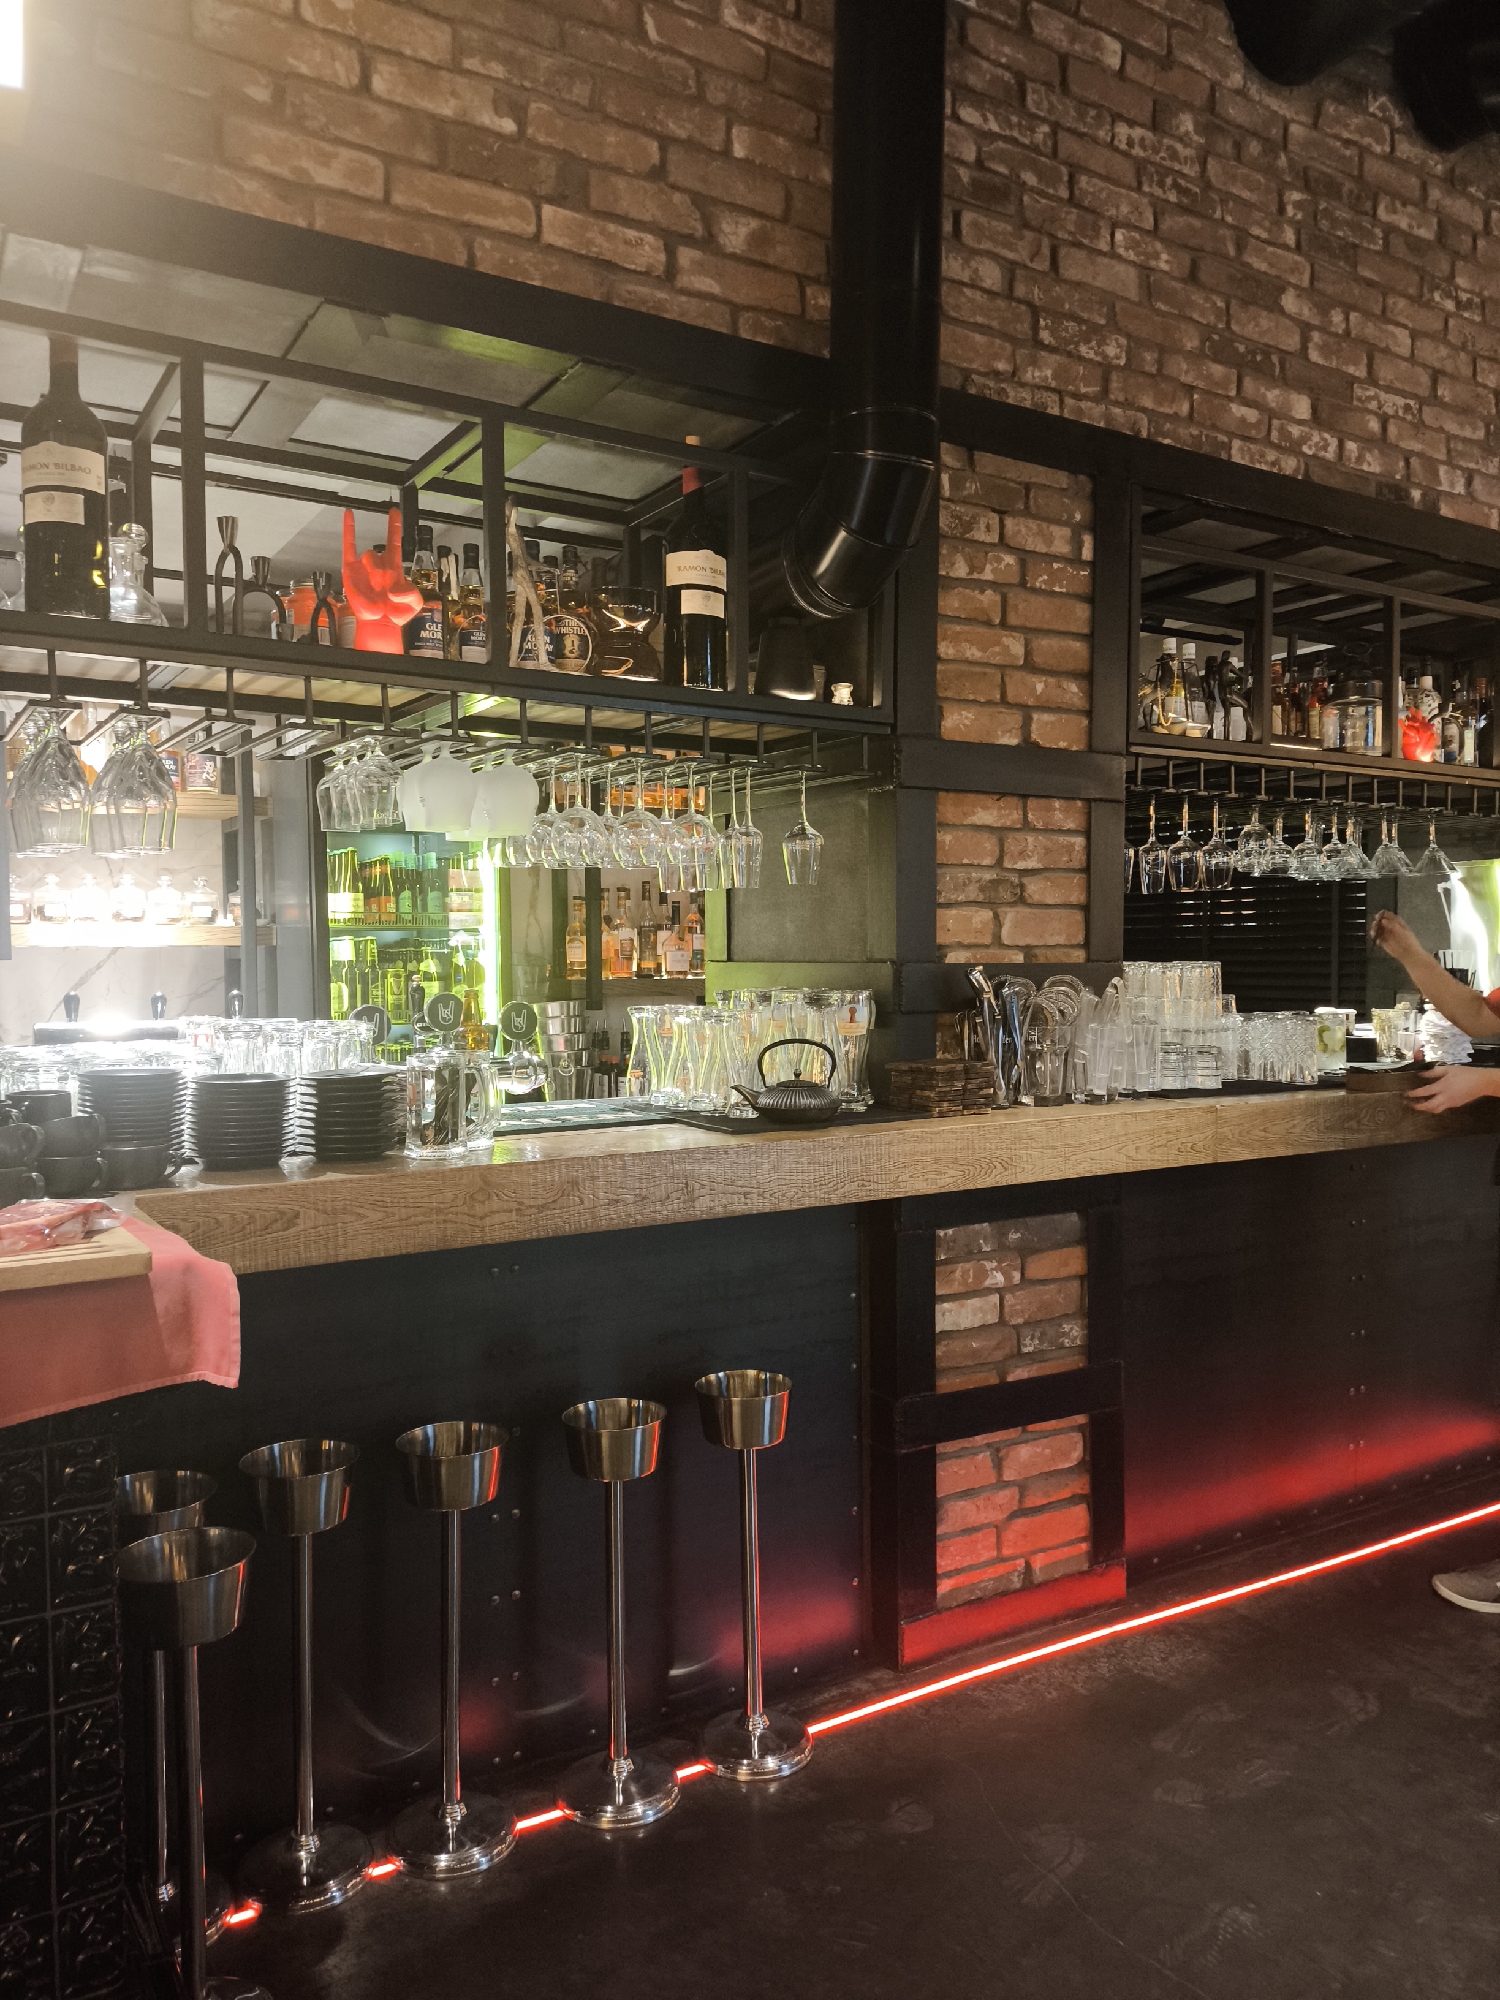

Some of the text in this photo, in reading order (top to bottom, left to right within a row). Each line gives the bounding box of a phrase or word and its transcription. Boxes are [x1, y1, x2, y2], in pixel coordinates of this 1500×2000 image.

[53, 462, 92, 475] BILBAO
[426, 622, 443, 633] GLE
[420, 630, 443, 641] MOR
